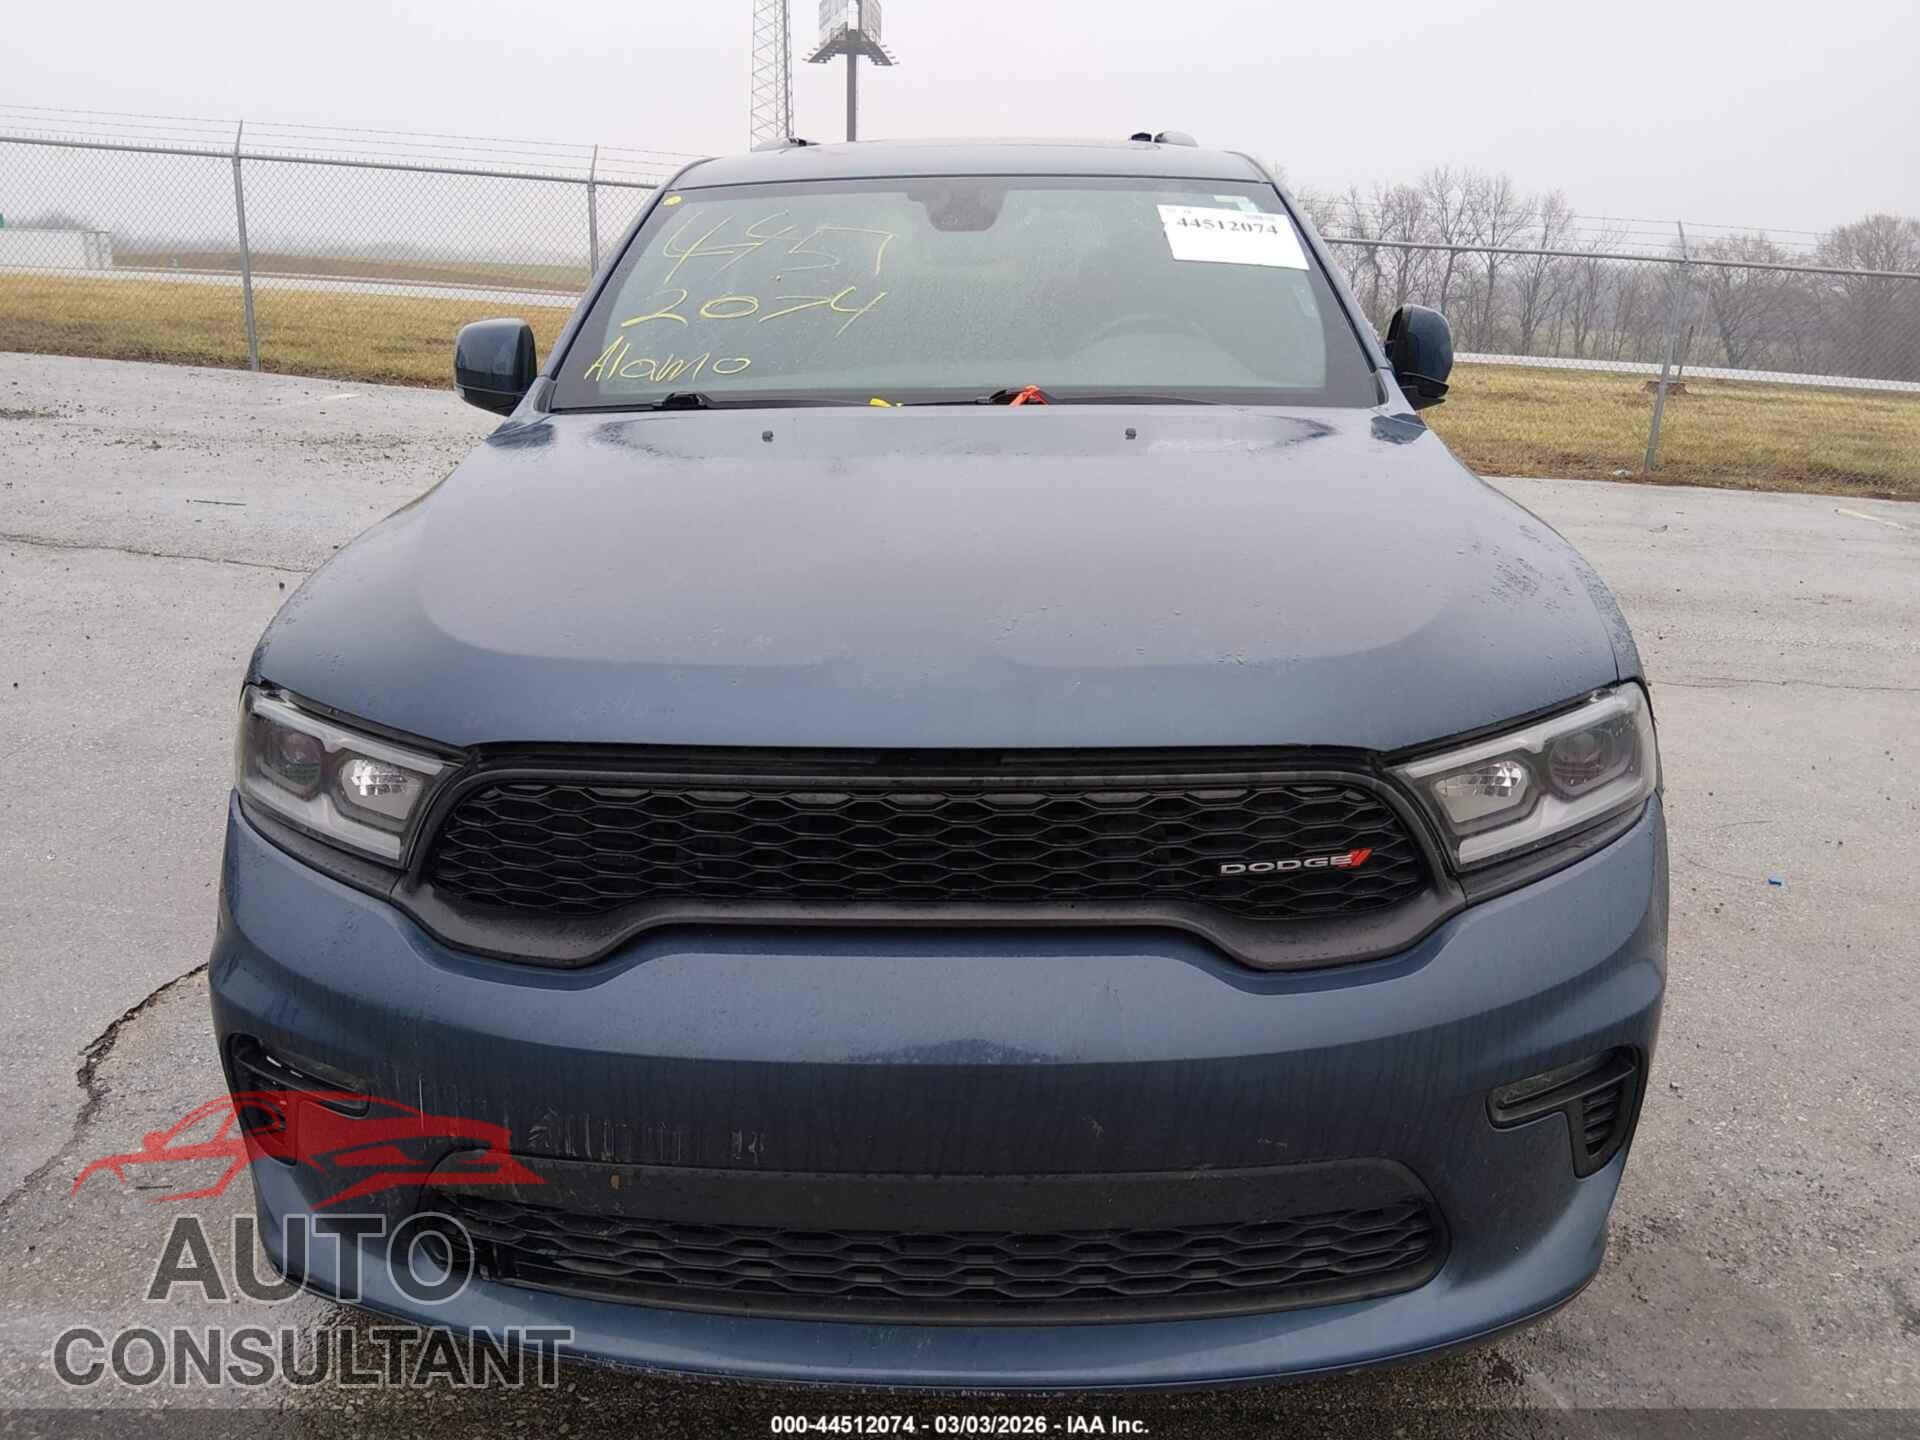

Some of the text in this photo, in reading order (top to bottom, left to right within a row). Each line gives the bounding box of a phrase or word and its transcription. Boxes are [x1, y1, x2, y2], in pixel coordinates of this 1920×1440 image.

[1176, 216, 1279, 235] 44512074
[584, 335, 751, 382] Alamo
[1220, 853, 1354, 875] DODGE
